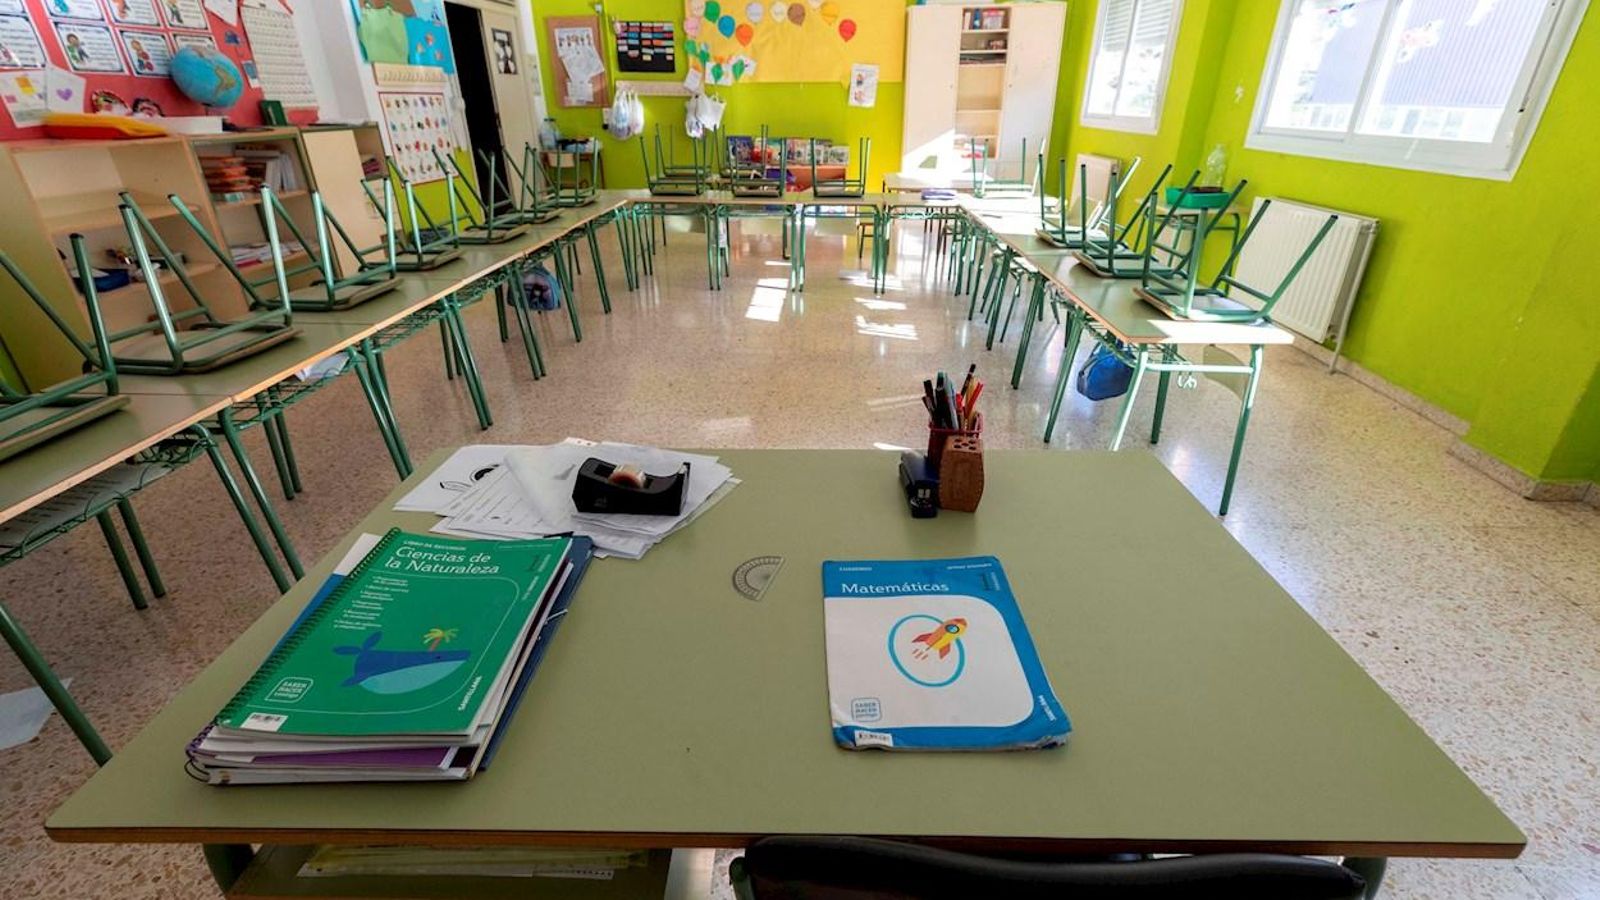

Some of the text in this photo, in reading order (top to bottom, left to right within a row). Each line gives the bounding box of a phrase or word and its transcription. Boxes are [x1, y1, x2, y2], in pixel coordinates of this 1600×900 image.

[395, 546, 491, 563] Ciencias de
[385, 557, 500, 574] la Naturaleza
[841, 582, 949, 594] Matemáticas
